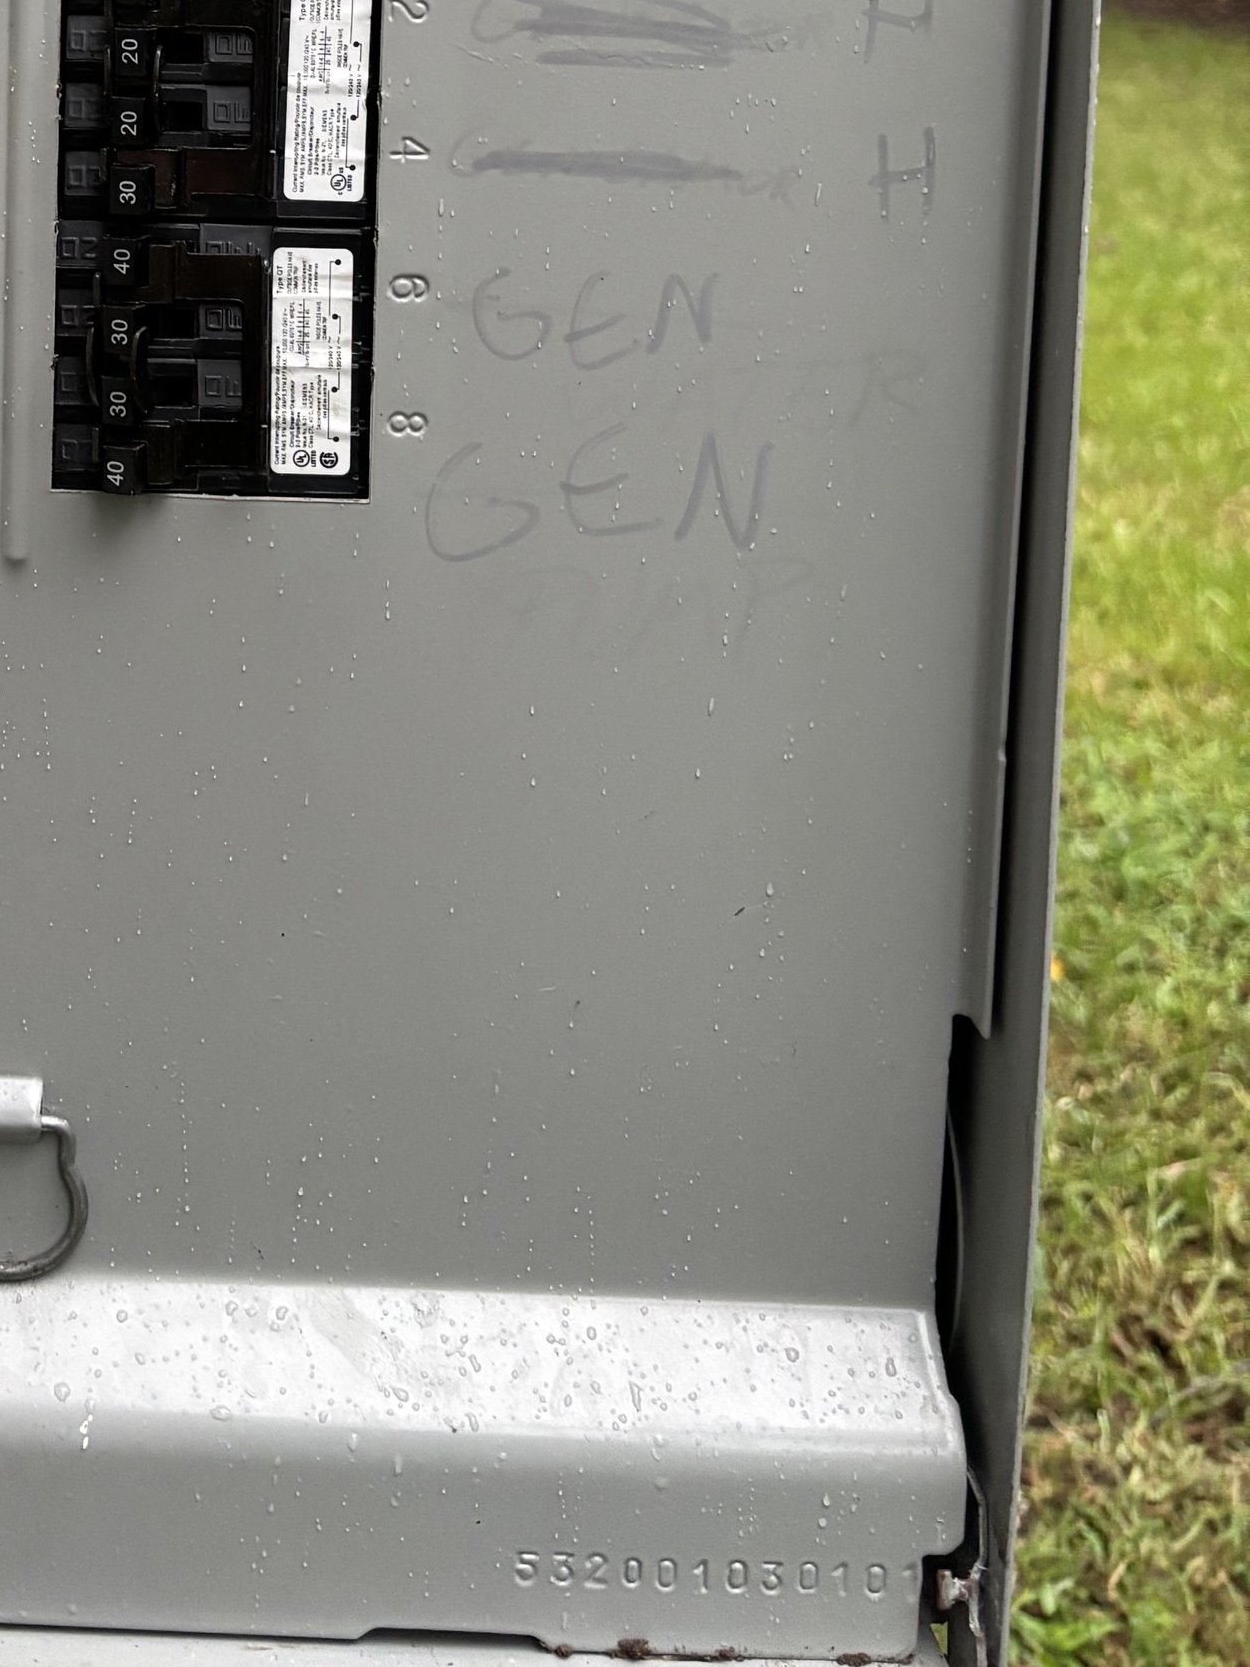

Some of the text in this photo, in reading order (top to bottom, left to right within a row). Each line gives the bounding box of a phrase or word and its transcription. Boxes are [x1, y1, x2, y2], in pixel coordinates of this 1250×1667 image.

[122, 38, 138, 65] 20
[120, 111, 137, 136] 20
[389, 135, 430, 162] 4
[119, 180, 137, 205] 30
[113, 249, 131, 274] 40
[111, 319, 128, 345] 30
[473, 268, 720, 370] GEN
[109, 391, 127, 417] 30
[387, 411, 429, 438] 8
[107, 461, 124, 487] 40
[424, 422, 777, 564] GEN
